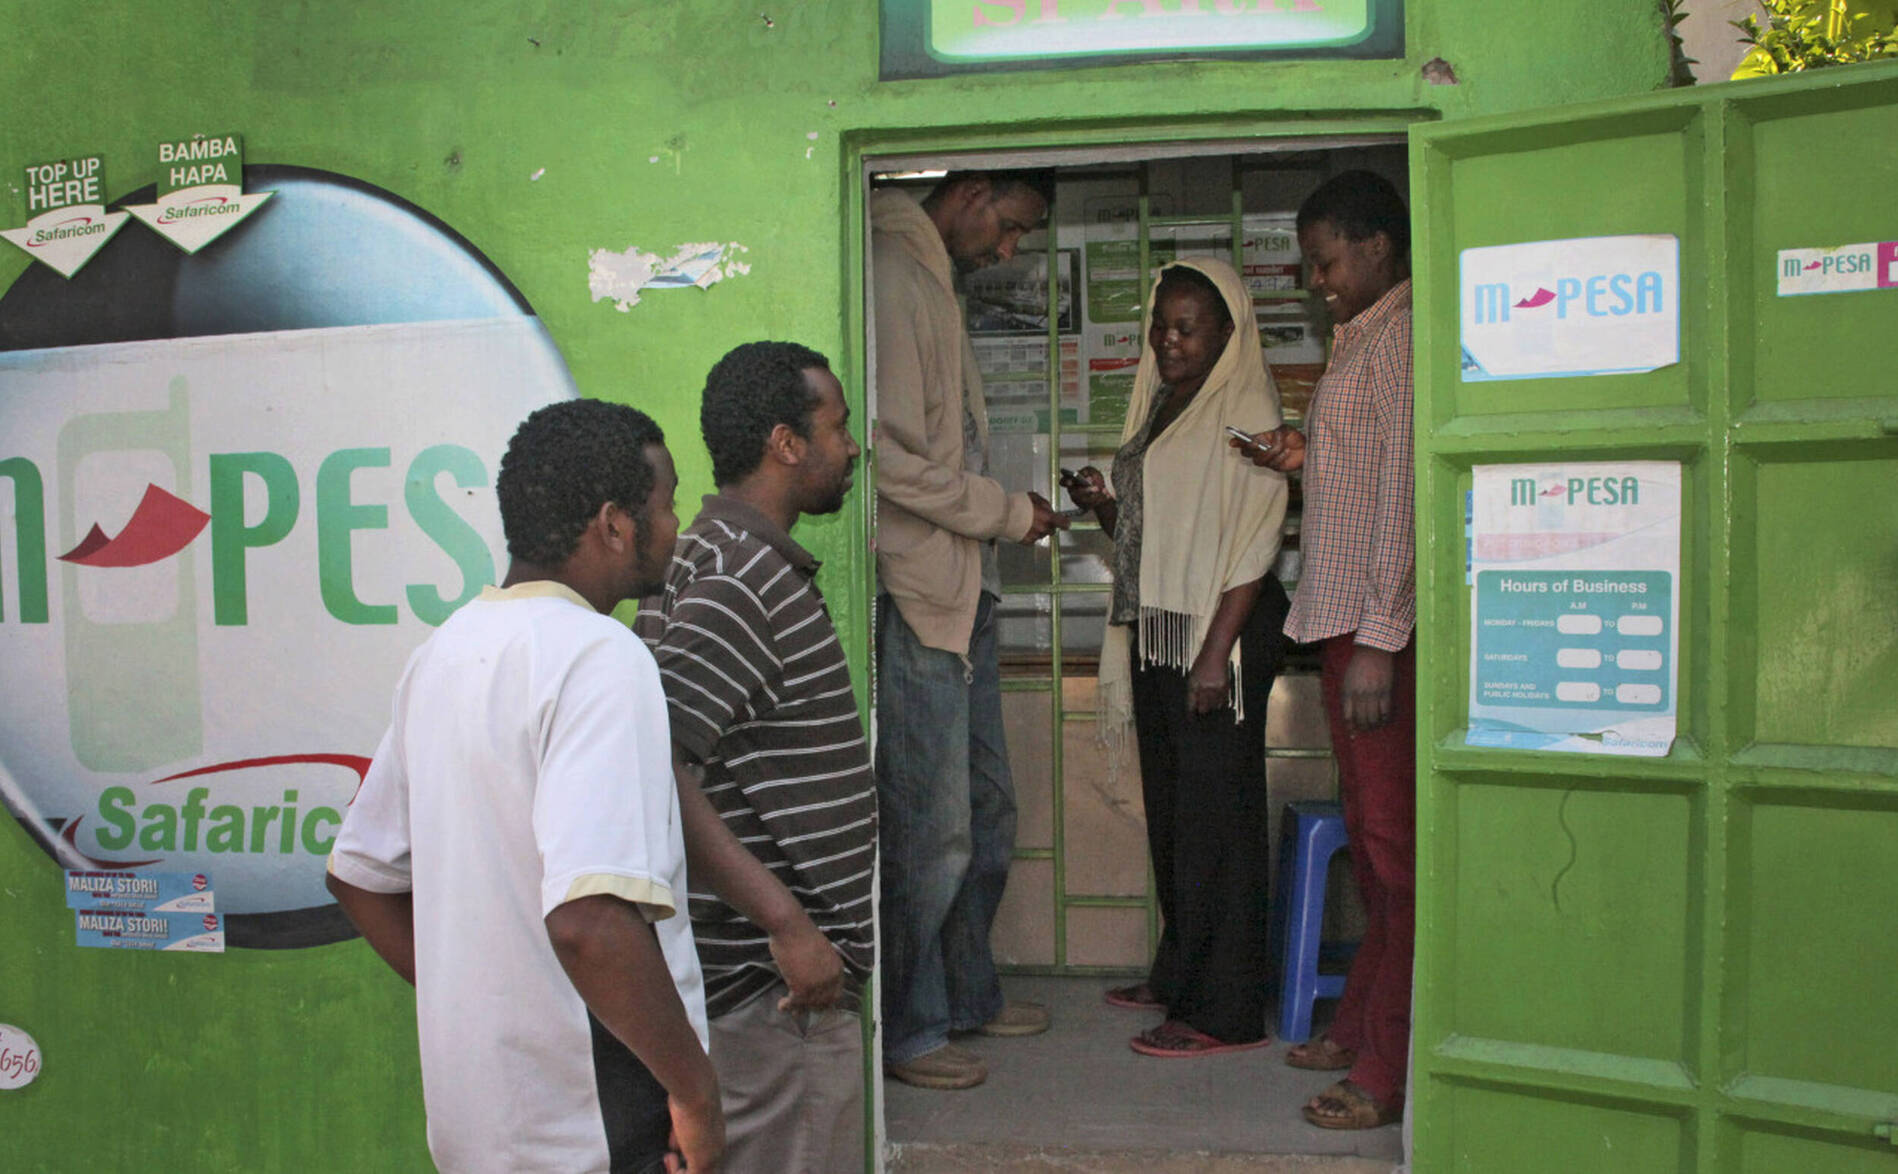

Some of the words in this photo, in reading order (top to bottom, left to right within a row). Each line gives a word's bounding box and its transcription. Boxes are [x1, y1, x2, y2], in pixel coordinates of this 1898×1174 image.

[159, 136, 238, 163] BAMBA
[26, 163, 67, 186] TOP
[73, 158, 100, 179] UP
[170, 163, 228, 187] HAPA
[29, 177, 100, 210] HERE
[164, 201, 240, 221] Safaricom
[35, 221, 106, 243] Safaricom
[1557, 271, 1663, 319] PESA
[1567, 476, 1639, 505] PESA
[209, 443, 497, 627] PES
[1500, 579, 1548, 593] Hours
[1552, 579, 1569, 593] of
[1573, 579, 1648, 593] Business
[1604, 619, 1616, 628] TO
[1604, 654, 1616, 663] TO
[1603, 688, 1615, 696] TO
[95, 786, 343, 856] Safaric
[68, 877, 115, 893] MALIZA
[79, 915, 125, 932] MALIZA
